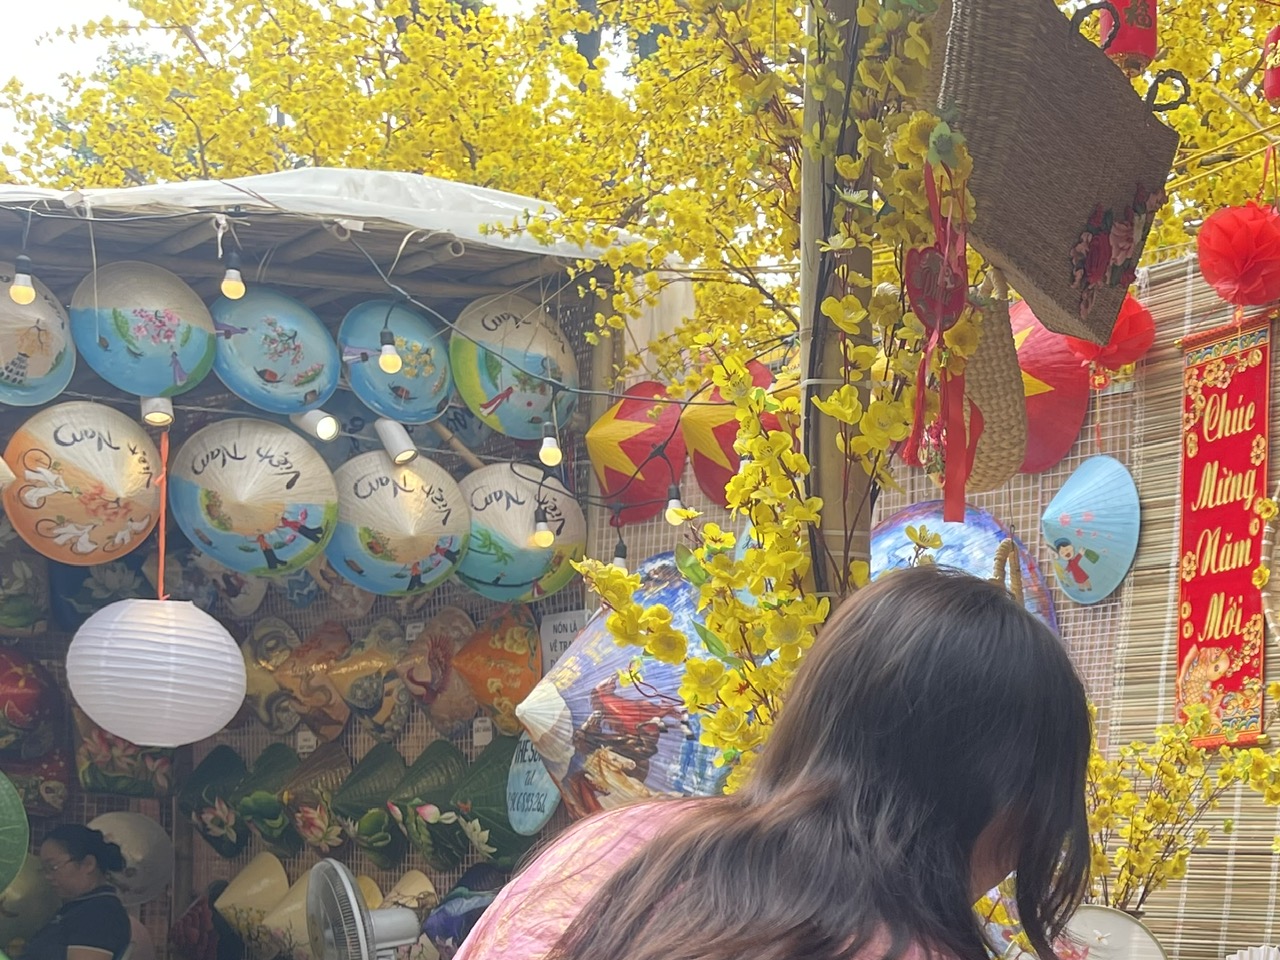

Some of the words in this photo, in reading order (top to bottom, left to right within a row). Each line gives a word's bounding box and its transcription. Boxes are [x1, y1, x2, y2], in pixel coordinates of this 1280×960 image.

[1203, 392, 1256, 443] Chúc
[1191, 460, 1258, 511] Mừng
[1196, 526, 1253, 576] Năm
[1198, 591, 1244, 643] Mới
